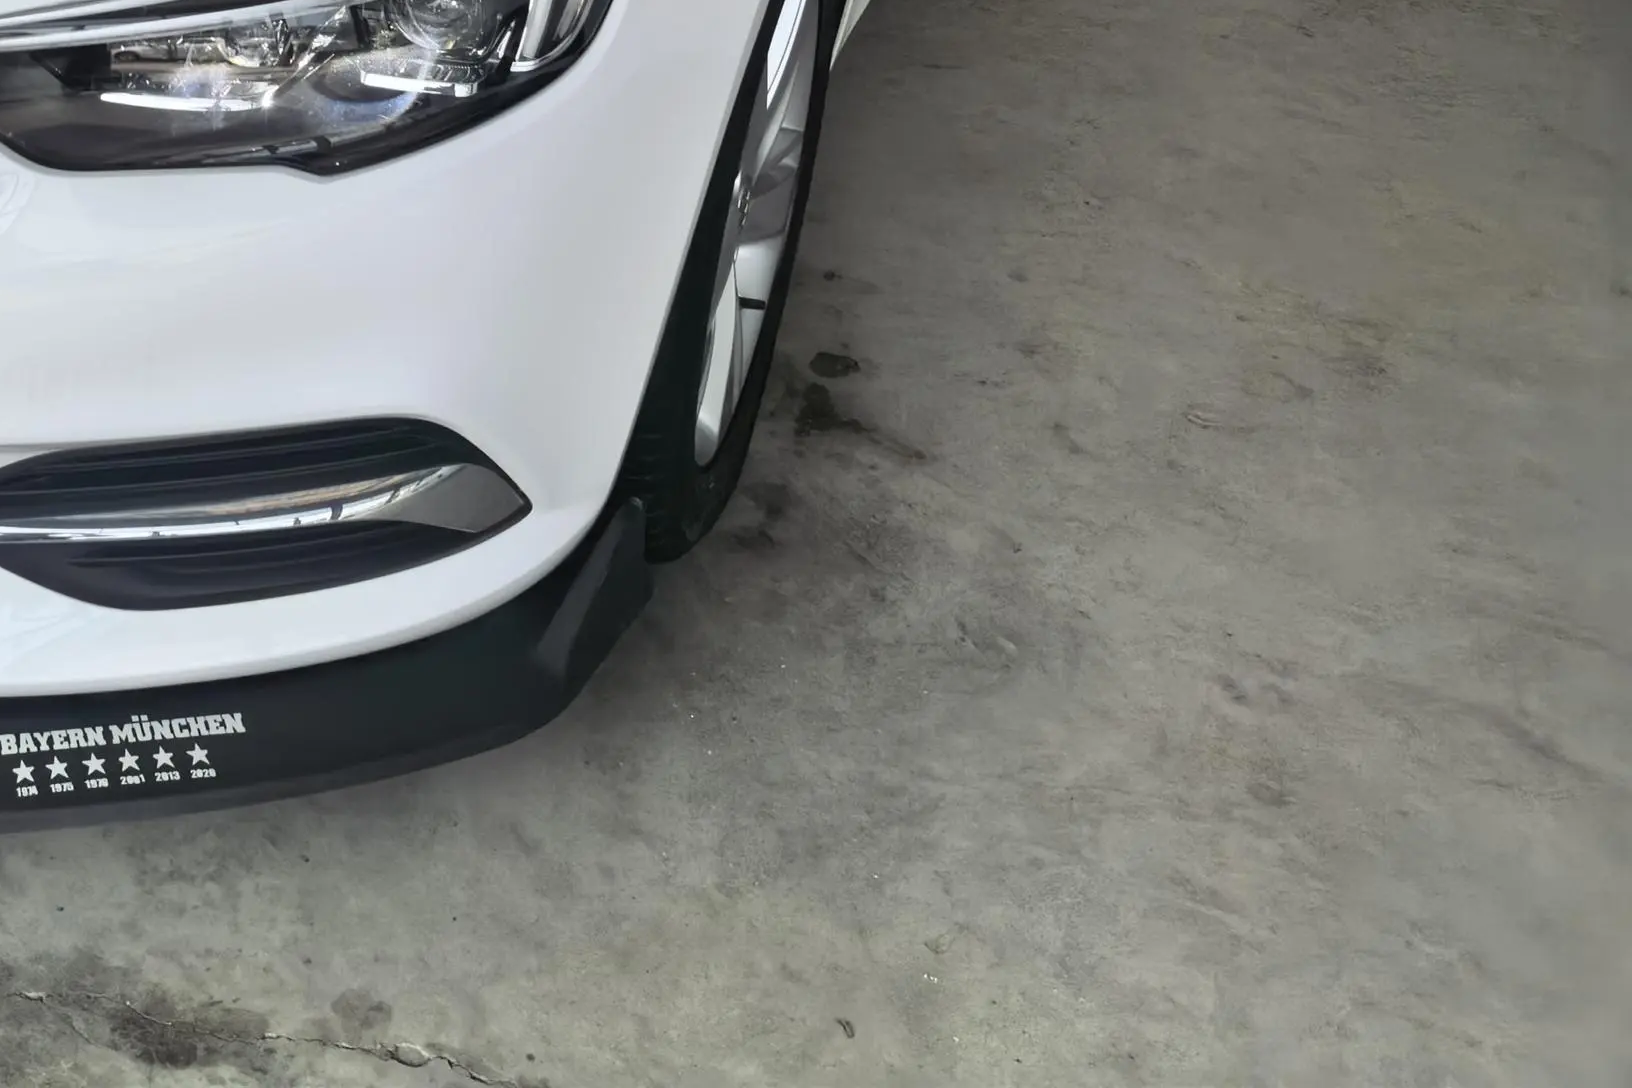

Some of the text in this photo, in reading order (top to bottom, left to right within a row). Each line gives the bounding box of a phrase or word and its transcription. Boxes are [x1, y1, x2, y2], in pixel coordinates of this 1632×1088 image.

[109, 712, 247, 745] MÜNCHEN
[50, 781, 74, 793] 1975
[154, 770, 181, 782] 2013
